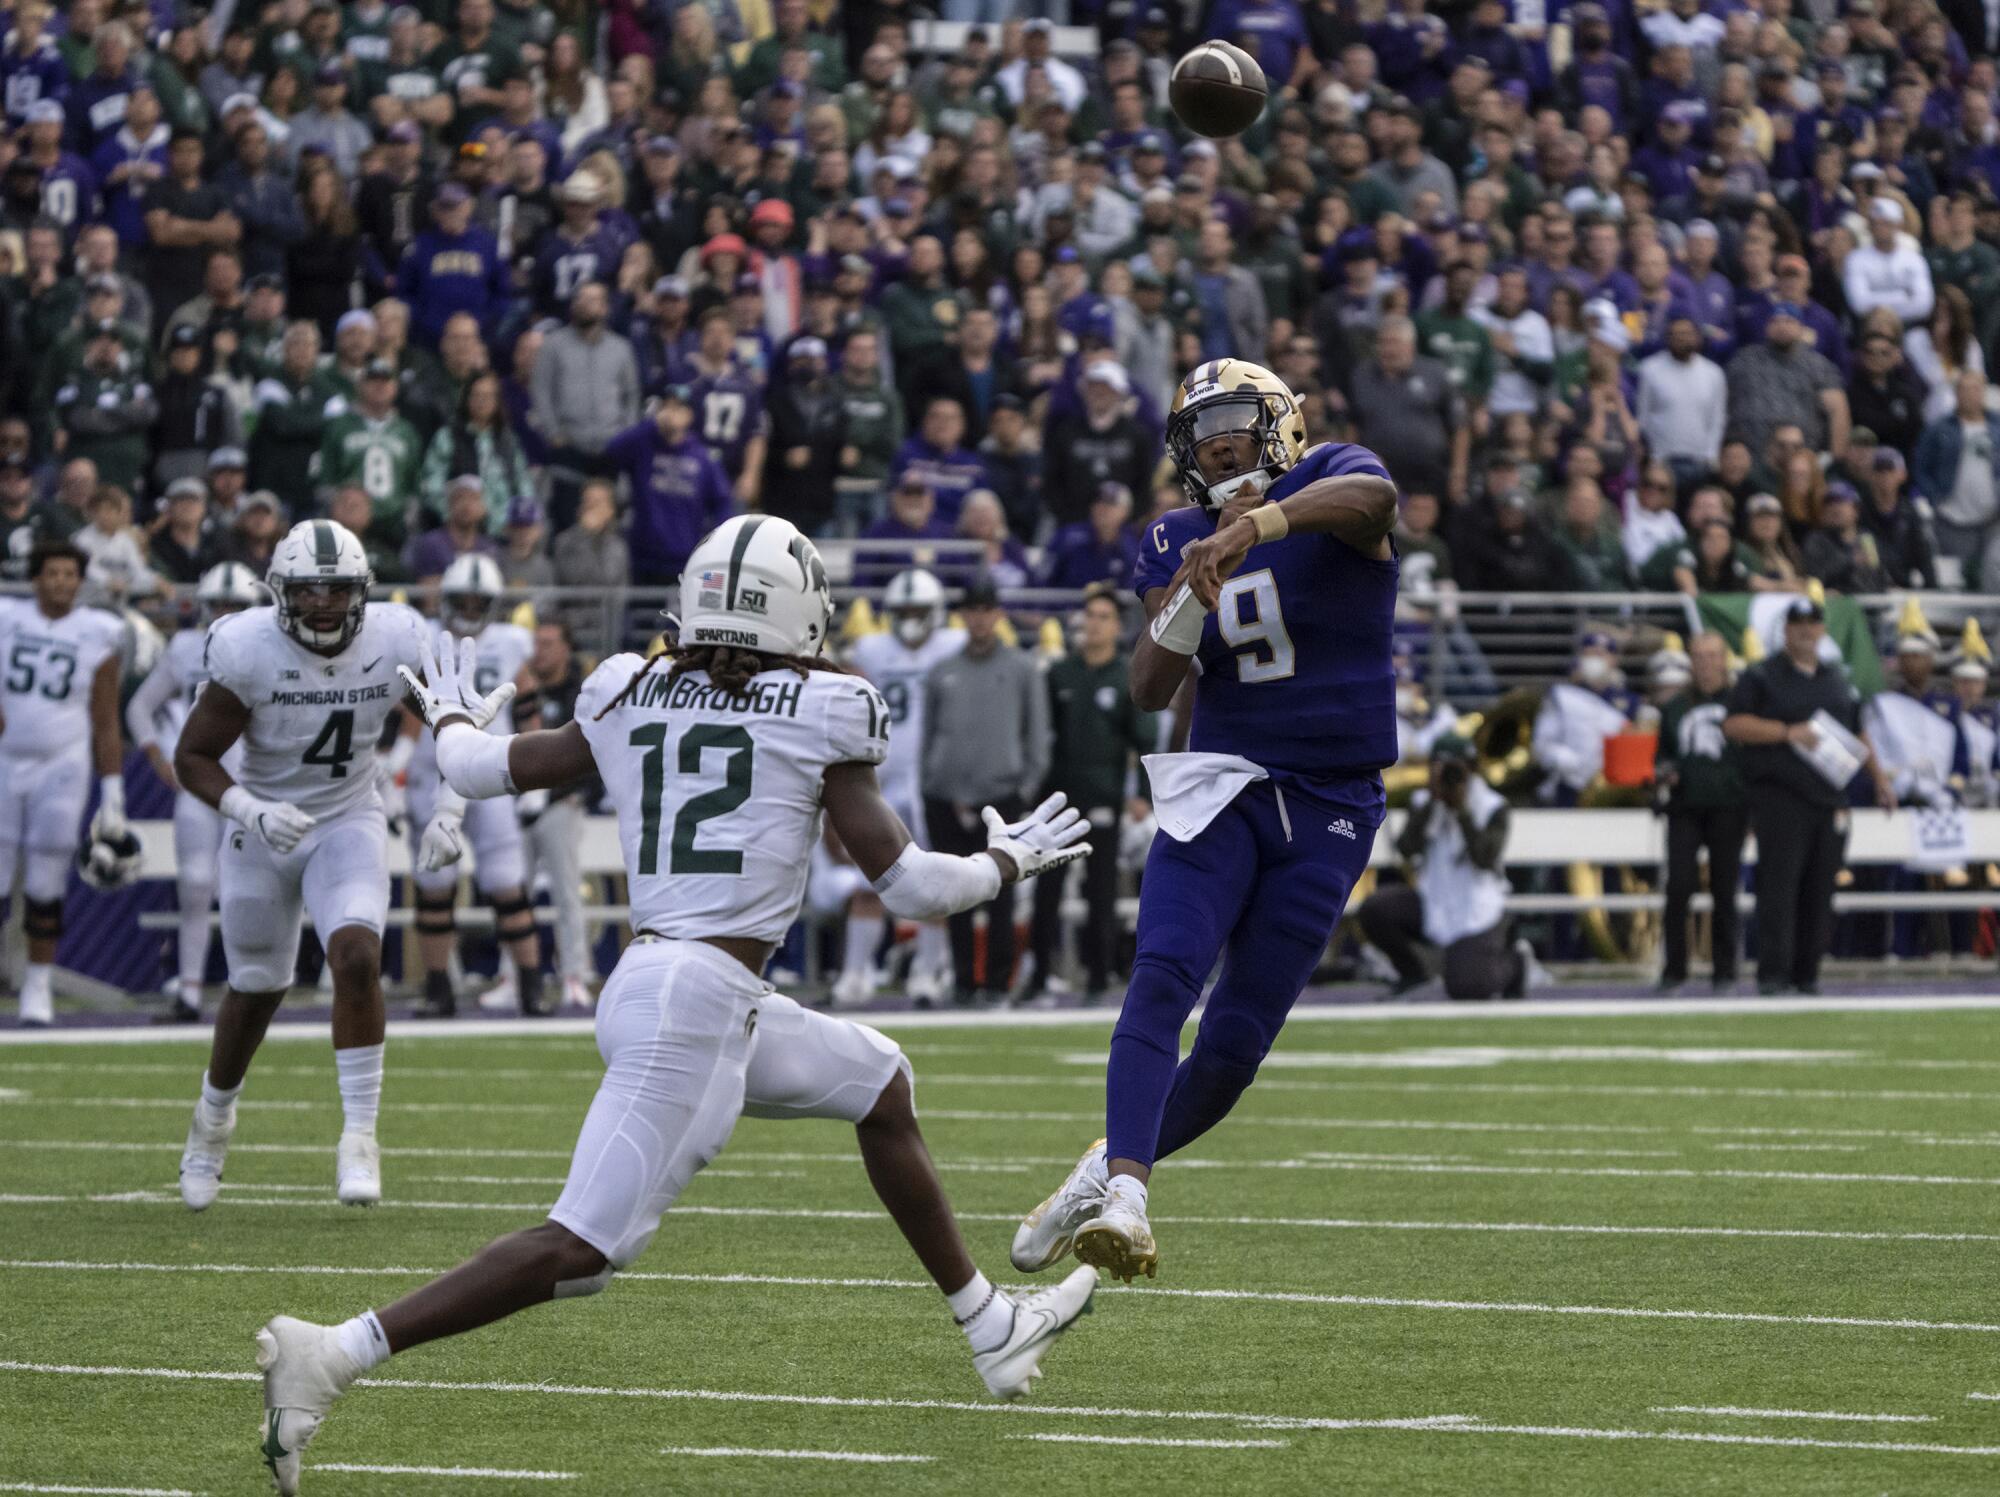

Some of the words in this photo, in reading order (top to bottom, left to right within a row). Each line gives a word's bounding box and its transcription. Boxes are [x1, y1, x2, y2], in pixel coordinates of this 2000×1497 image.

[1188, 385, 1215, 400] DAWGS
[1153, 523, 1169, 554] C
[695, 628, 758, 646] SPARTANS
[1217, 567, 1296, 684] 9
[7, 646, 77, 700] 53
[271, 690, 344, 706] MICHIGAN
[348, 683, 389, 704] STATE
[302, 709, 354, 778] 4
[629, 722, 754, 874] 12
[1327, 825, 1357, 840] adidas
